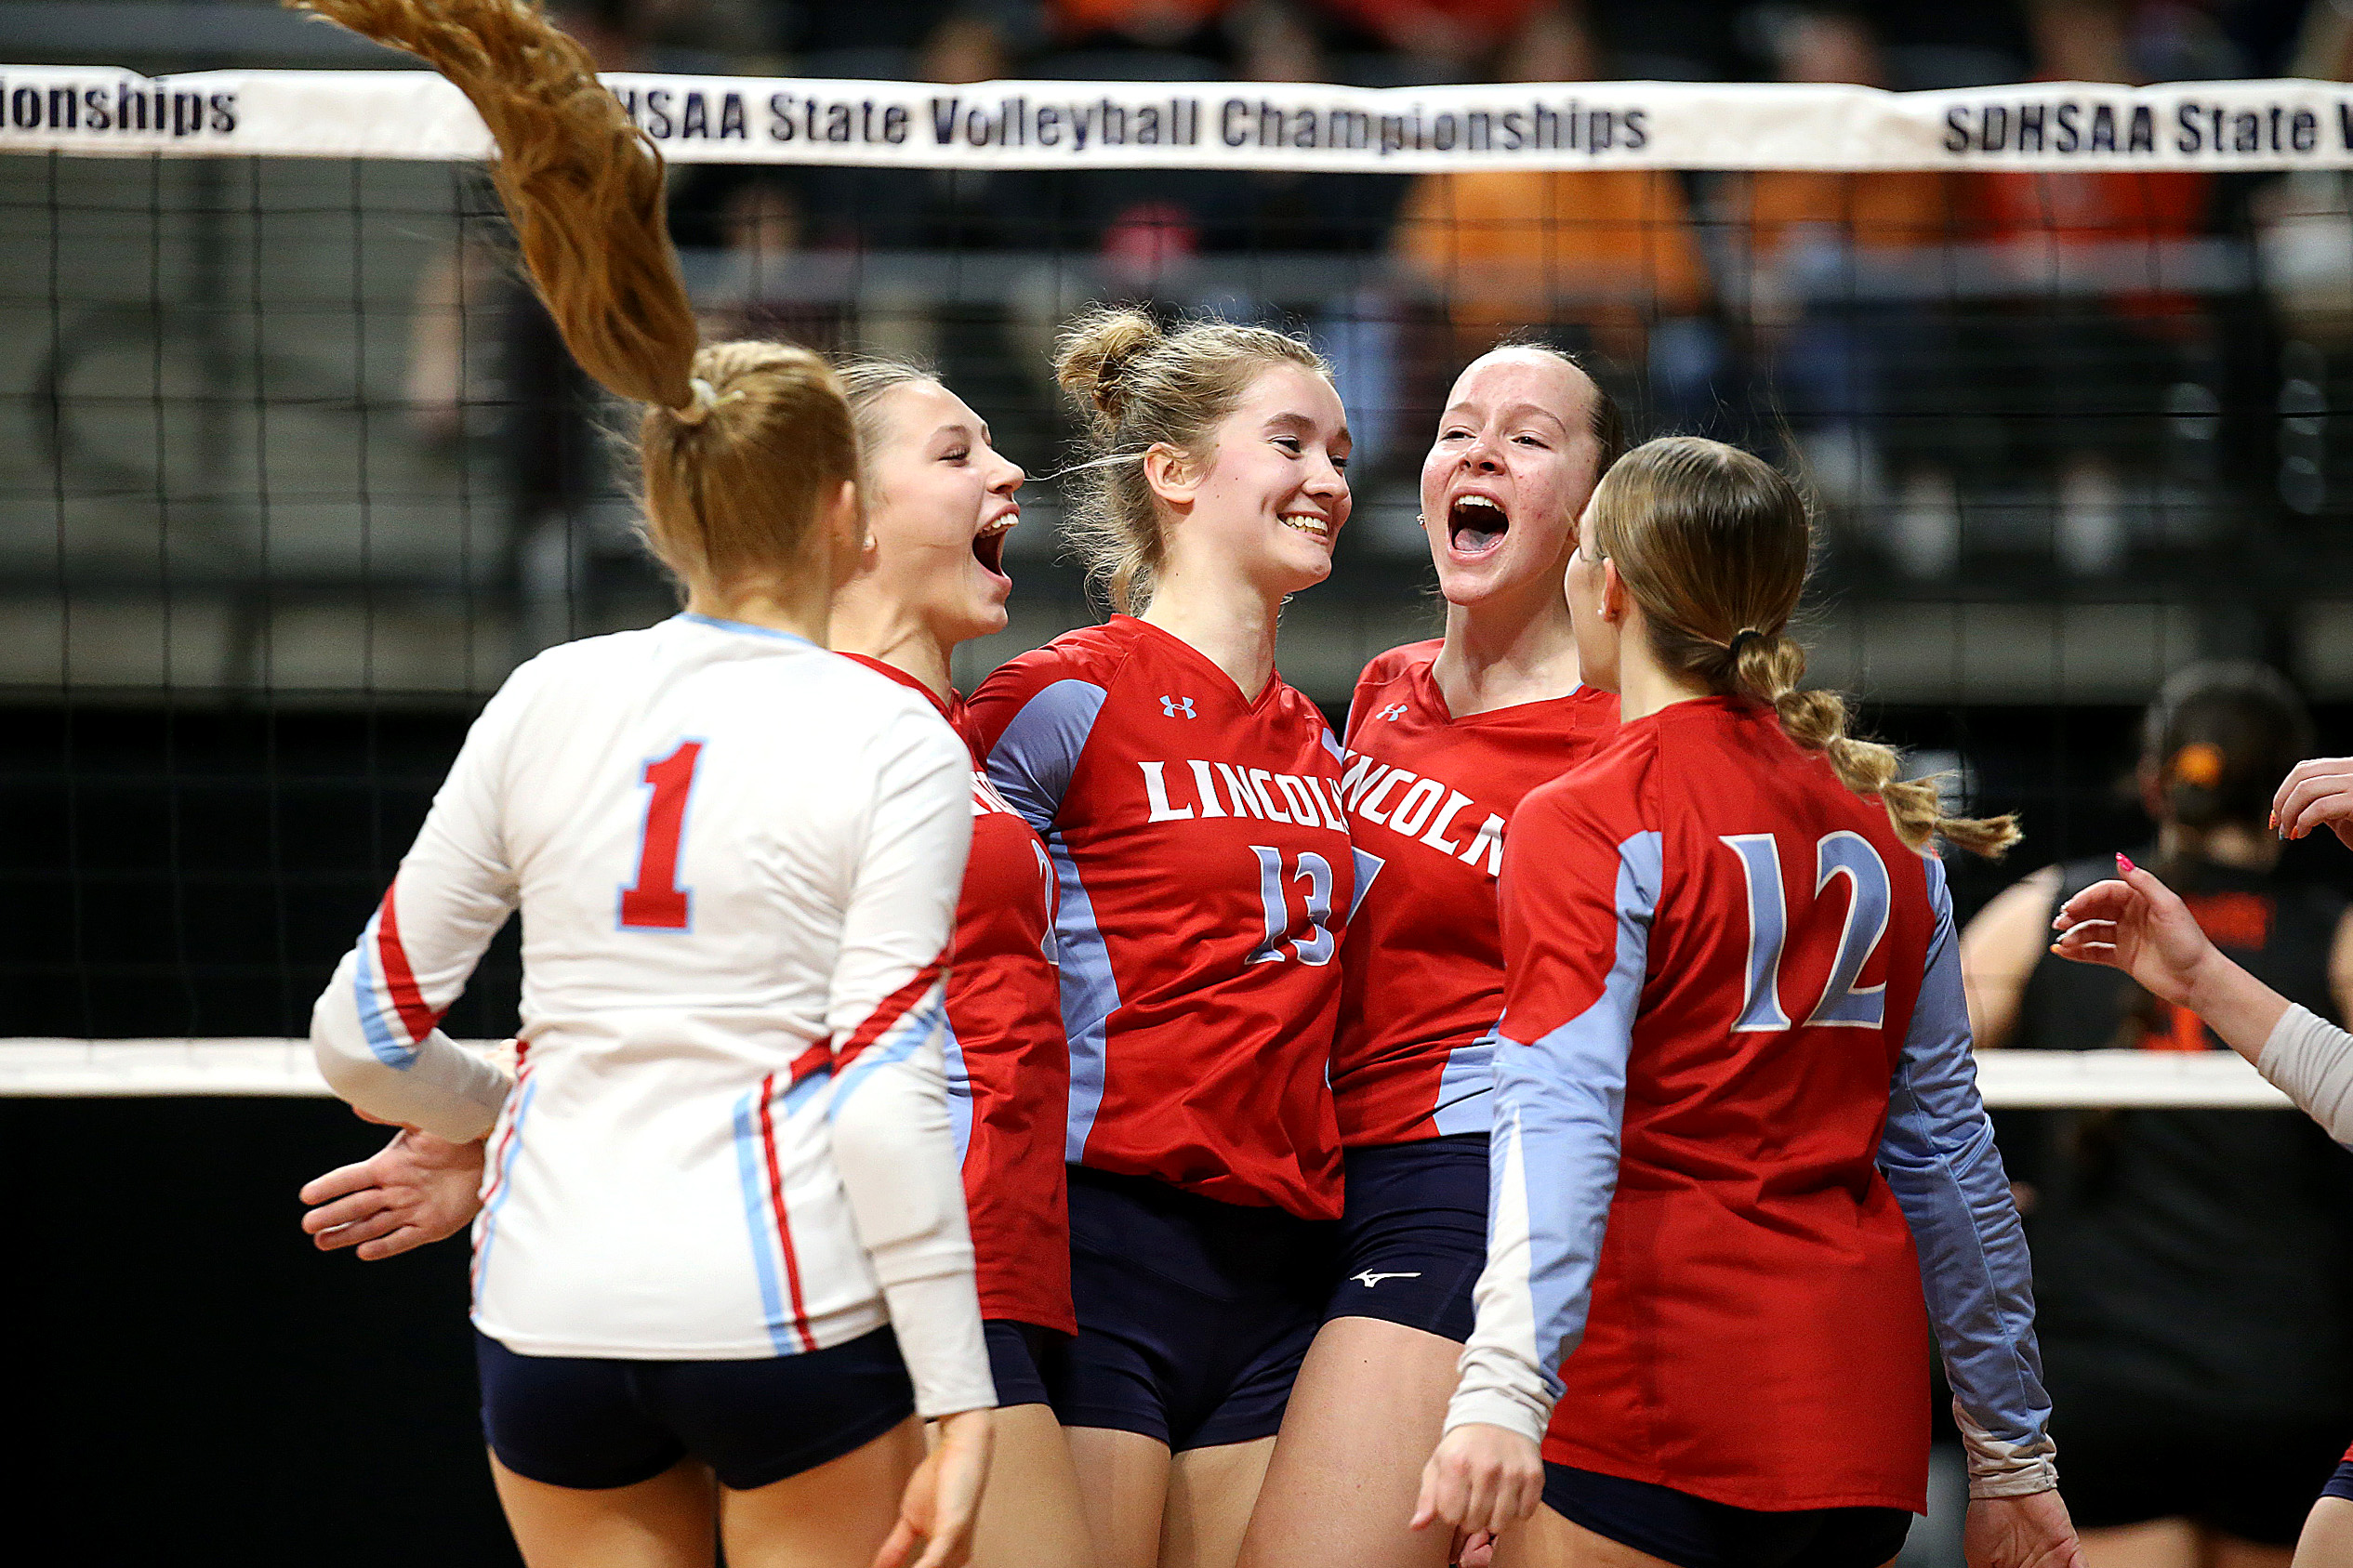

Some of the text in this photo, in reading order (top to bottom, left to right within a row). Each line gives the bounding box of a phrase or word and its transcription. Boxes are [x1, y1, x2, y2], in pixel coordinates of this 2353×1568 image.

[770, 93, 907, 144] State
[931, 98, 1196, 152] Volleyball
[1221, 99, 1646, 154] Championships
[1946, 104, 2154, 152] SDHSAA
[2177, 104, 2317, 152] State
[615, 735, 710, 935] 1
[1343, 749, 1506, 877] NCOLN
[1244, 845, 1336, 967] 13
[1718, 829, 1892, 1033] 12
